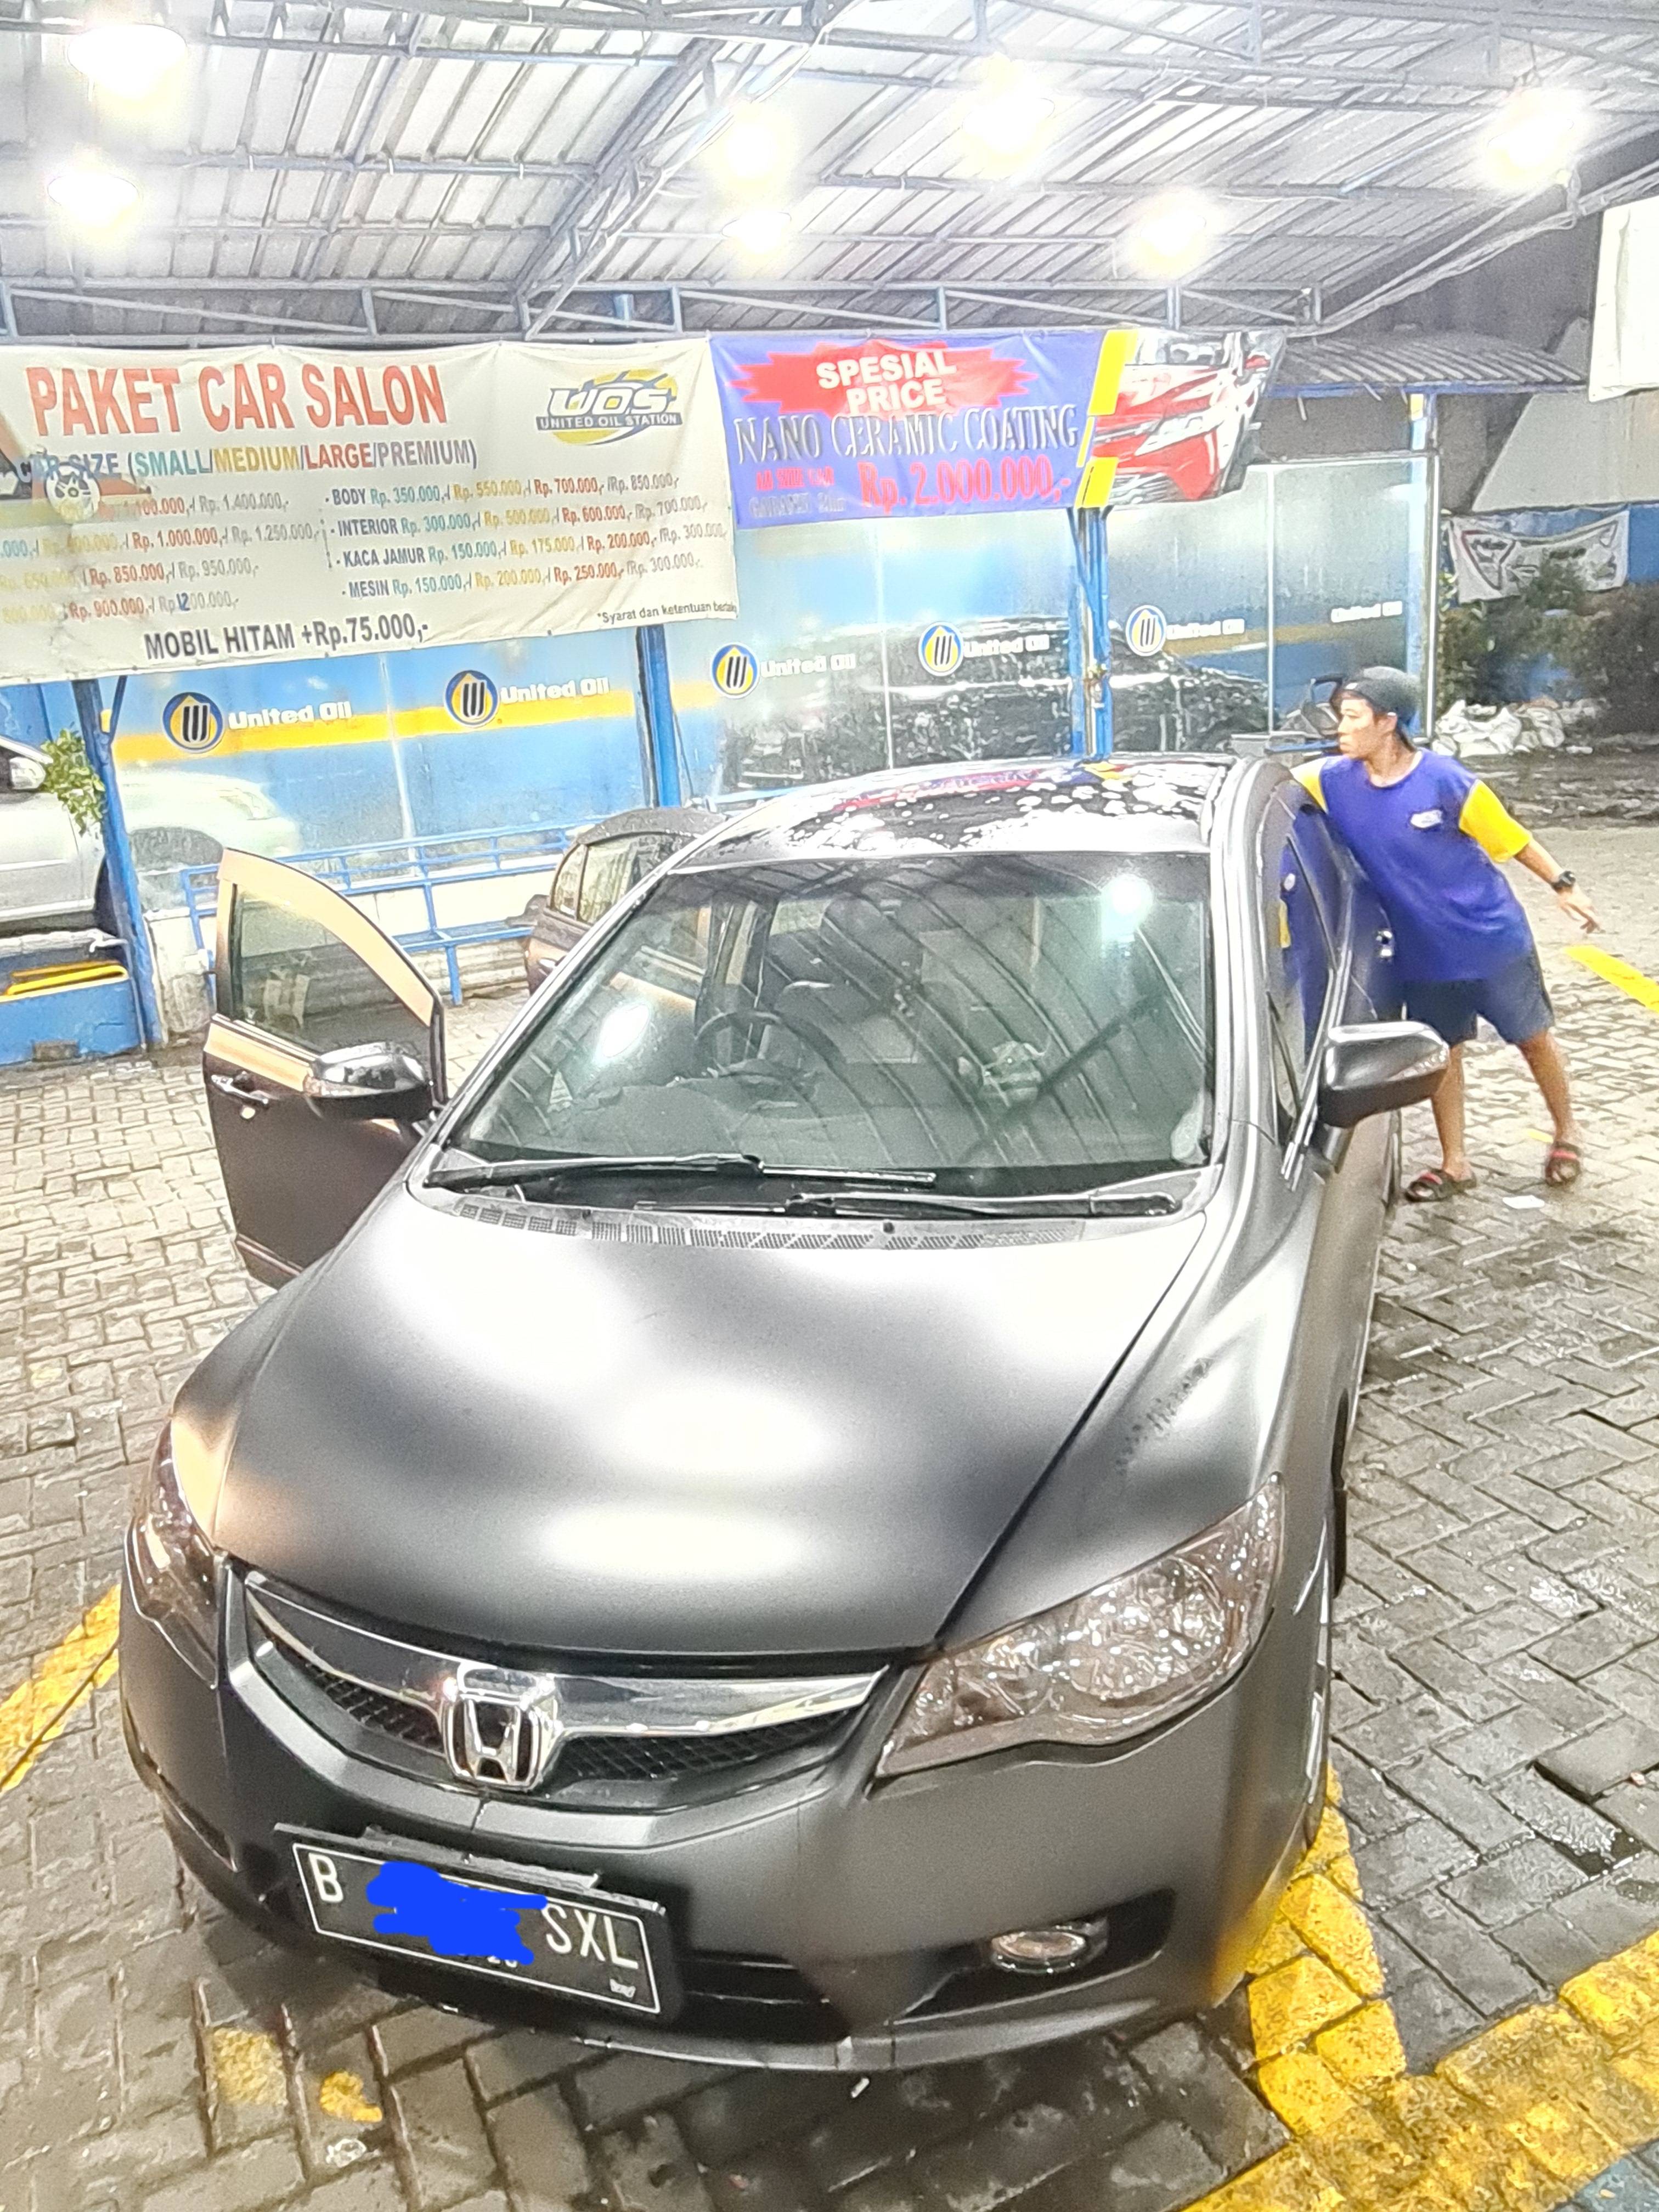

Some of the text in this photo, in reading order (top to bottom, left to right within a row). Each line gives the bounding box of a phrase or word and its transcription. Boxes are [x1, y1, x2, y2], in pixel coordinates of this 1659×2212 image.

[816, 349, 957, 389] SPESIAL
[26, 363, 447, 436] PAKET CAR SALON
[548, 387, 672, 416] UOS
[845, 377, 947, 414] PRICE
[539, 414, 678, 430] UNITED OIL STATION
[733, 404, 1079, 464] NANO CERAMIC COATING
[331, 488, 366, 505] BODY
[370, 488, 391, 507] Rp.
[453, 483, 473, 503] Rp.
[534, 478, 552, 498] Rp.
[857, 461, 907, 515] Rp.
[909, 453, 1071, 506] 2.000.000,-
[199, 495, 219, 516] Rp.
[337, 518, 398, 537] INTERIOR
[400, 517, 421, 537] Rp.
[484, 510, 503, 530] Rp.
[562, 507, 580, 527] Rp.
[132, 531, 154, 553] Rp.
[231, 525, 252, 546] Rp.
[343, 549, 380, 568] KACA
[383, 547, 426, 565] JAMUR
[428, 545, 448, 566] Rp.
[509, 539, 529, 558] Rp.
[586, 535, 605, 554] Rp.
[89, 568, 111, 589] Rp.
[178, 561, 200, 582] Rp.
[348, 579, 390, 599] MESIN
[392, 578, 413, 599] Rp.
[475, 572, 494, 591] Rp.
[554, 566, 572, 586] Rp.
[69, 601, 92, 623] Rp.
[639, 607, 659, 618] dan
[144, 612, 428, 660] MOBIL HITAM +Rp.75.000,-
[963, 636, 1024, 658] United
[760, 653, 856, 678] United Oil
[500, 677, 610, 704] United Oil
[228, 701, 352, 730] United Oil
[308, 1852, 639, 1971] B SXL
